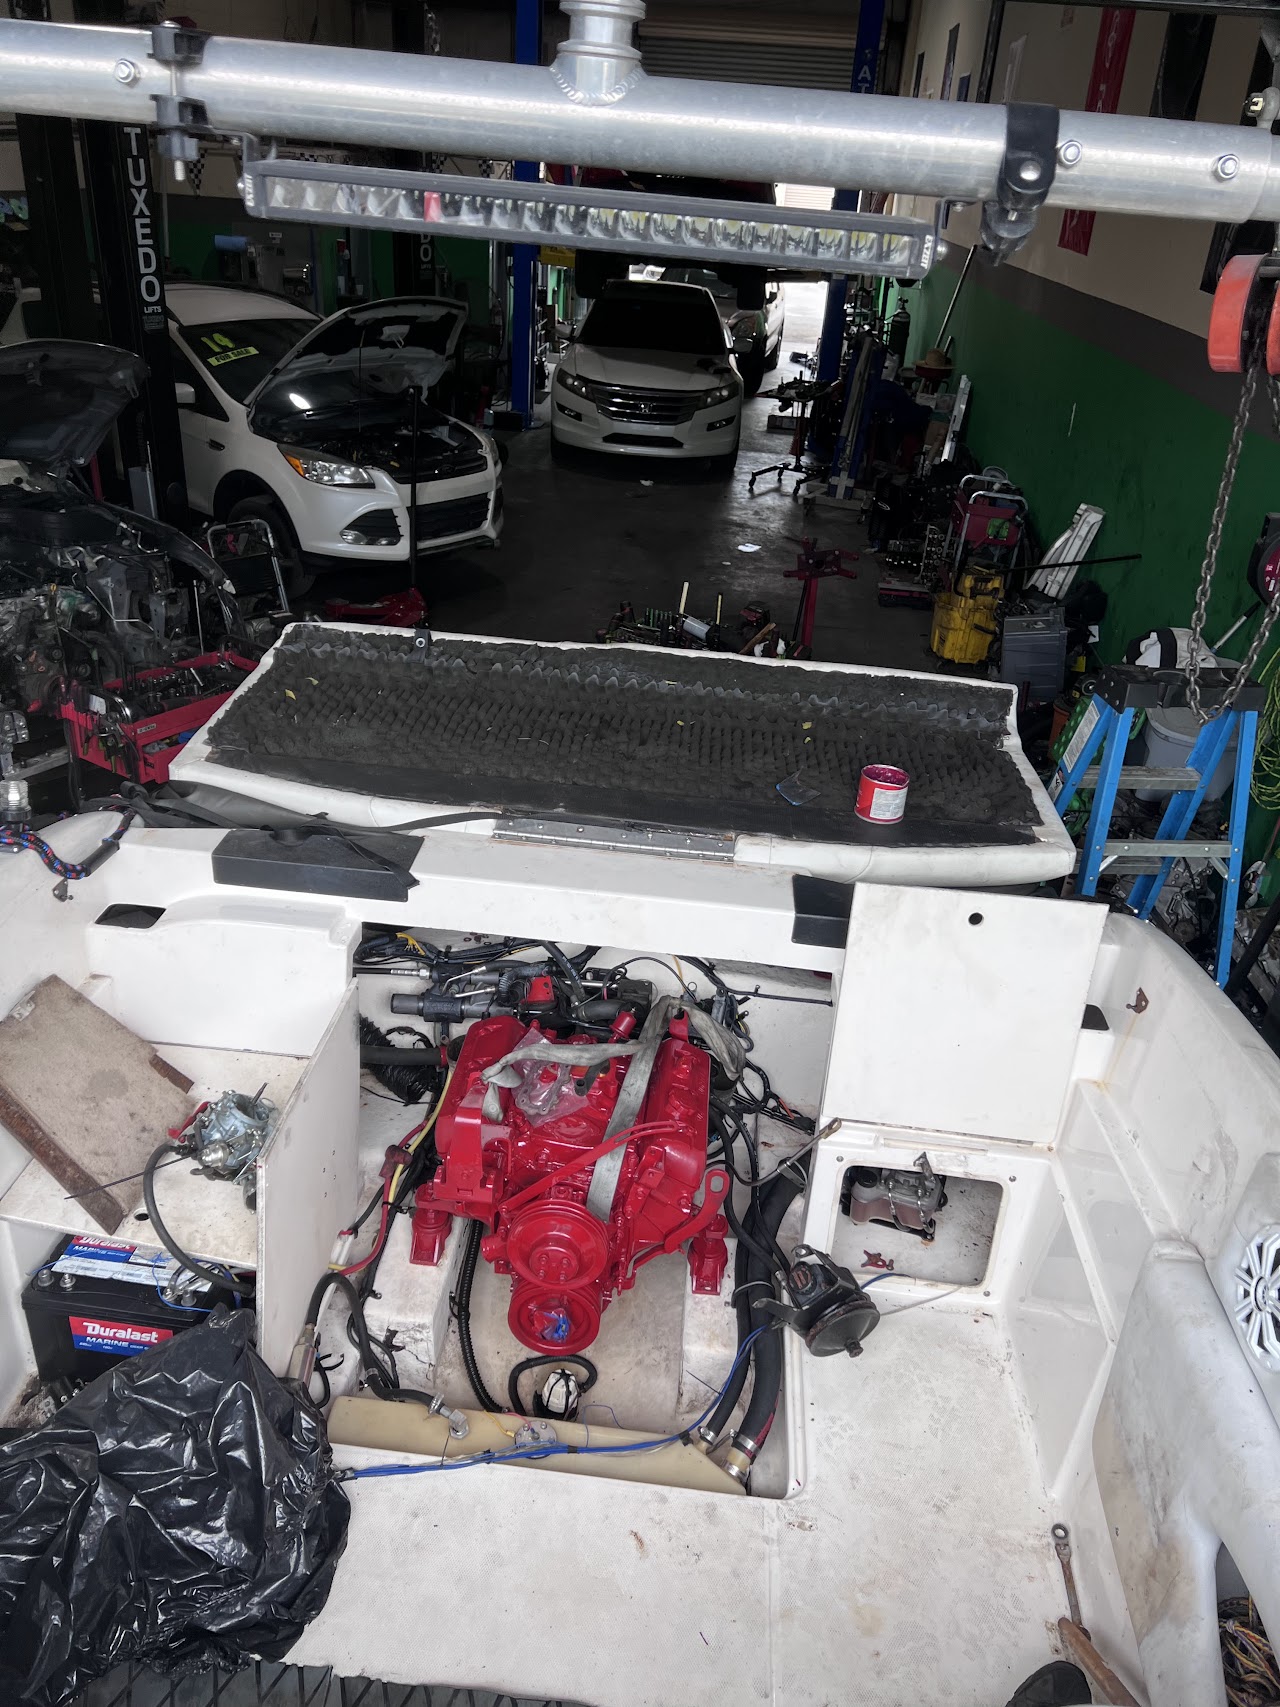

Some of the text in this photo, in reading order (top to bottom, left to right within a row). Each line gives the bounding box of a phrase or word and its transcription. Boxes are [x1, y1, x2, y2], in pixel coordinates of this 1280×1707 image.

[123, 126, 161, 303] TUXEDO
[214, 348, 252, 363] FOR SALE
[83, 1322, 158, 1343] Duralast
[86, 1336, 129, 1348] MARINE
